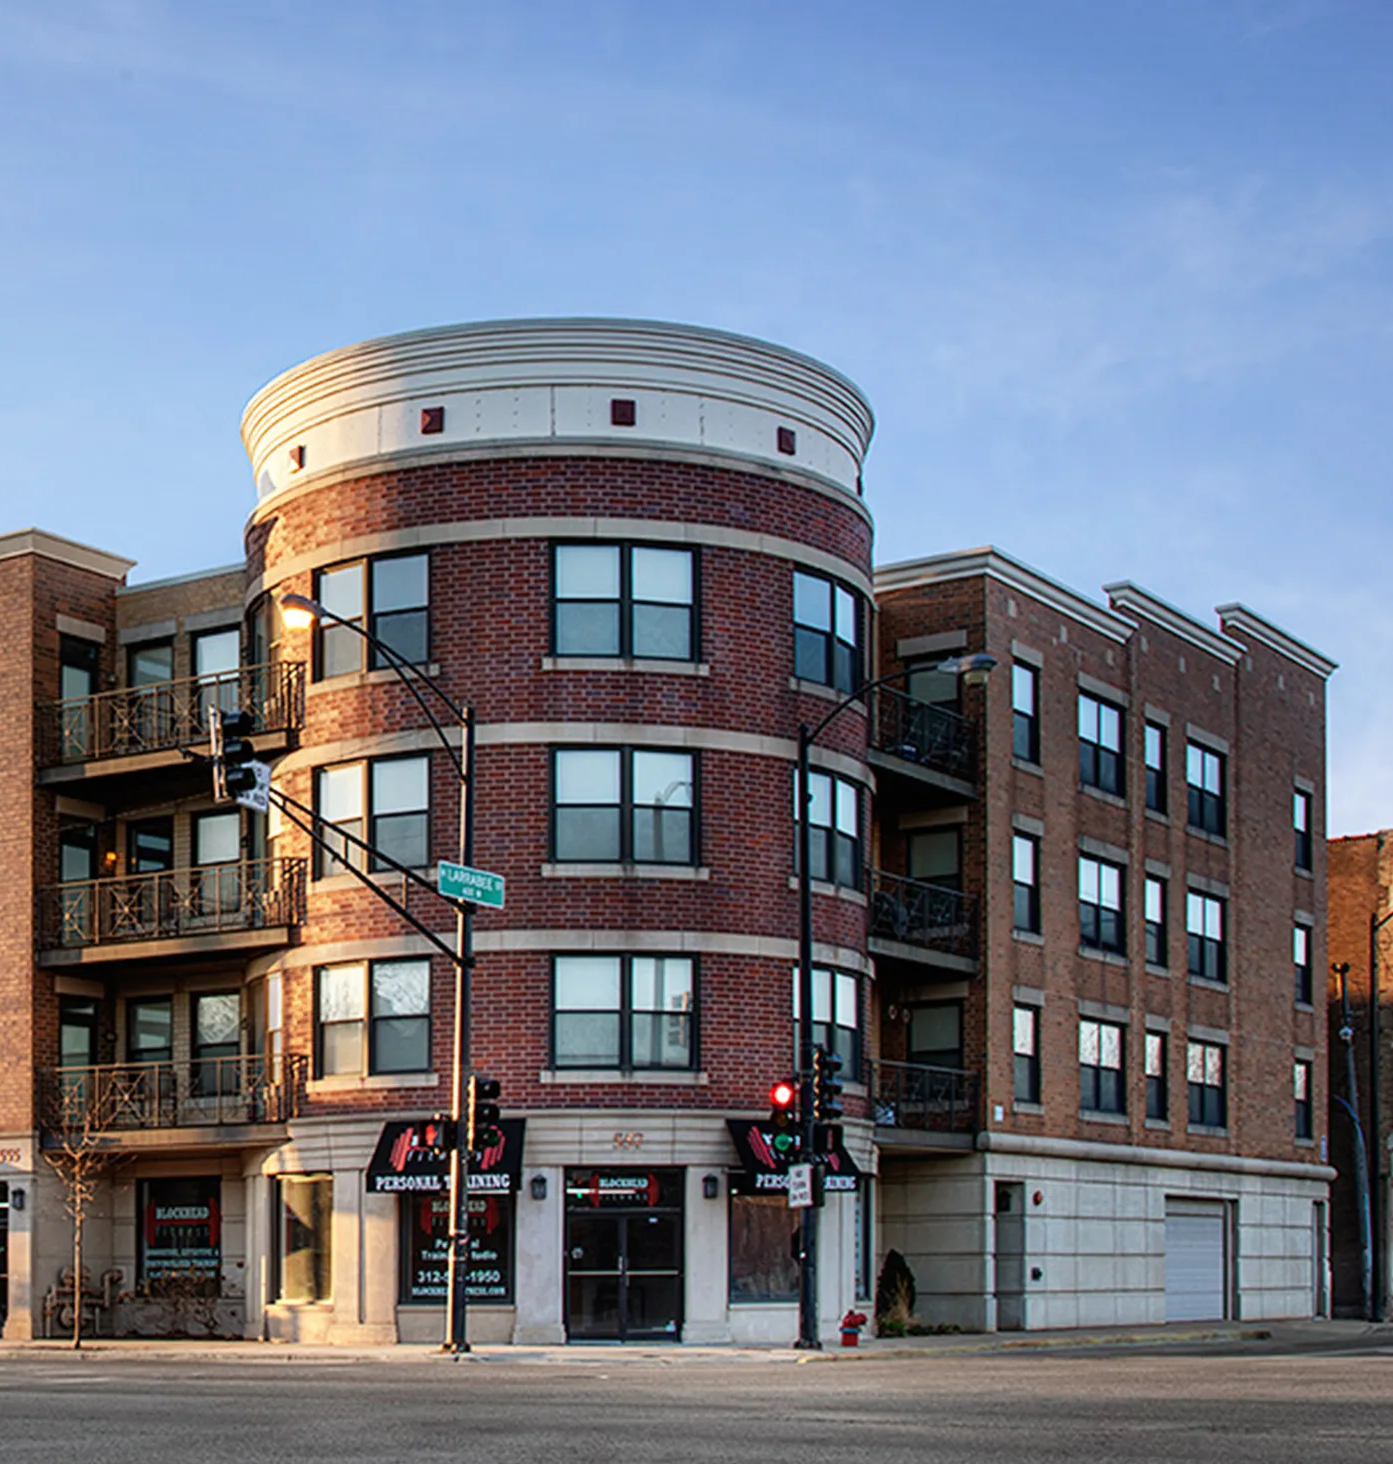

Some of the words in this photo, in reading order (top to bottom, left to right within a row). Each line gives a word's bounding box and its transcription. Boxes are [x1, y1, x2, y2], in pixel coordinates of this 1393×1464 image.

[448, 868, 493, 891] LARRABEE
[613, 1132, 644, 1149] 557
[0, 1148, 20, 1163] 555
[376, 1175, 441, 1190] PERSONAL
[599, 1178, 648, 1188] BLOCKHEAD
[156, 1206, 209, 1219] BLOCKHEAD
